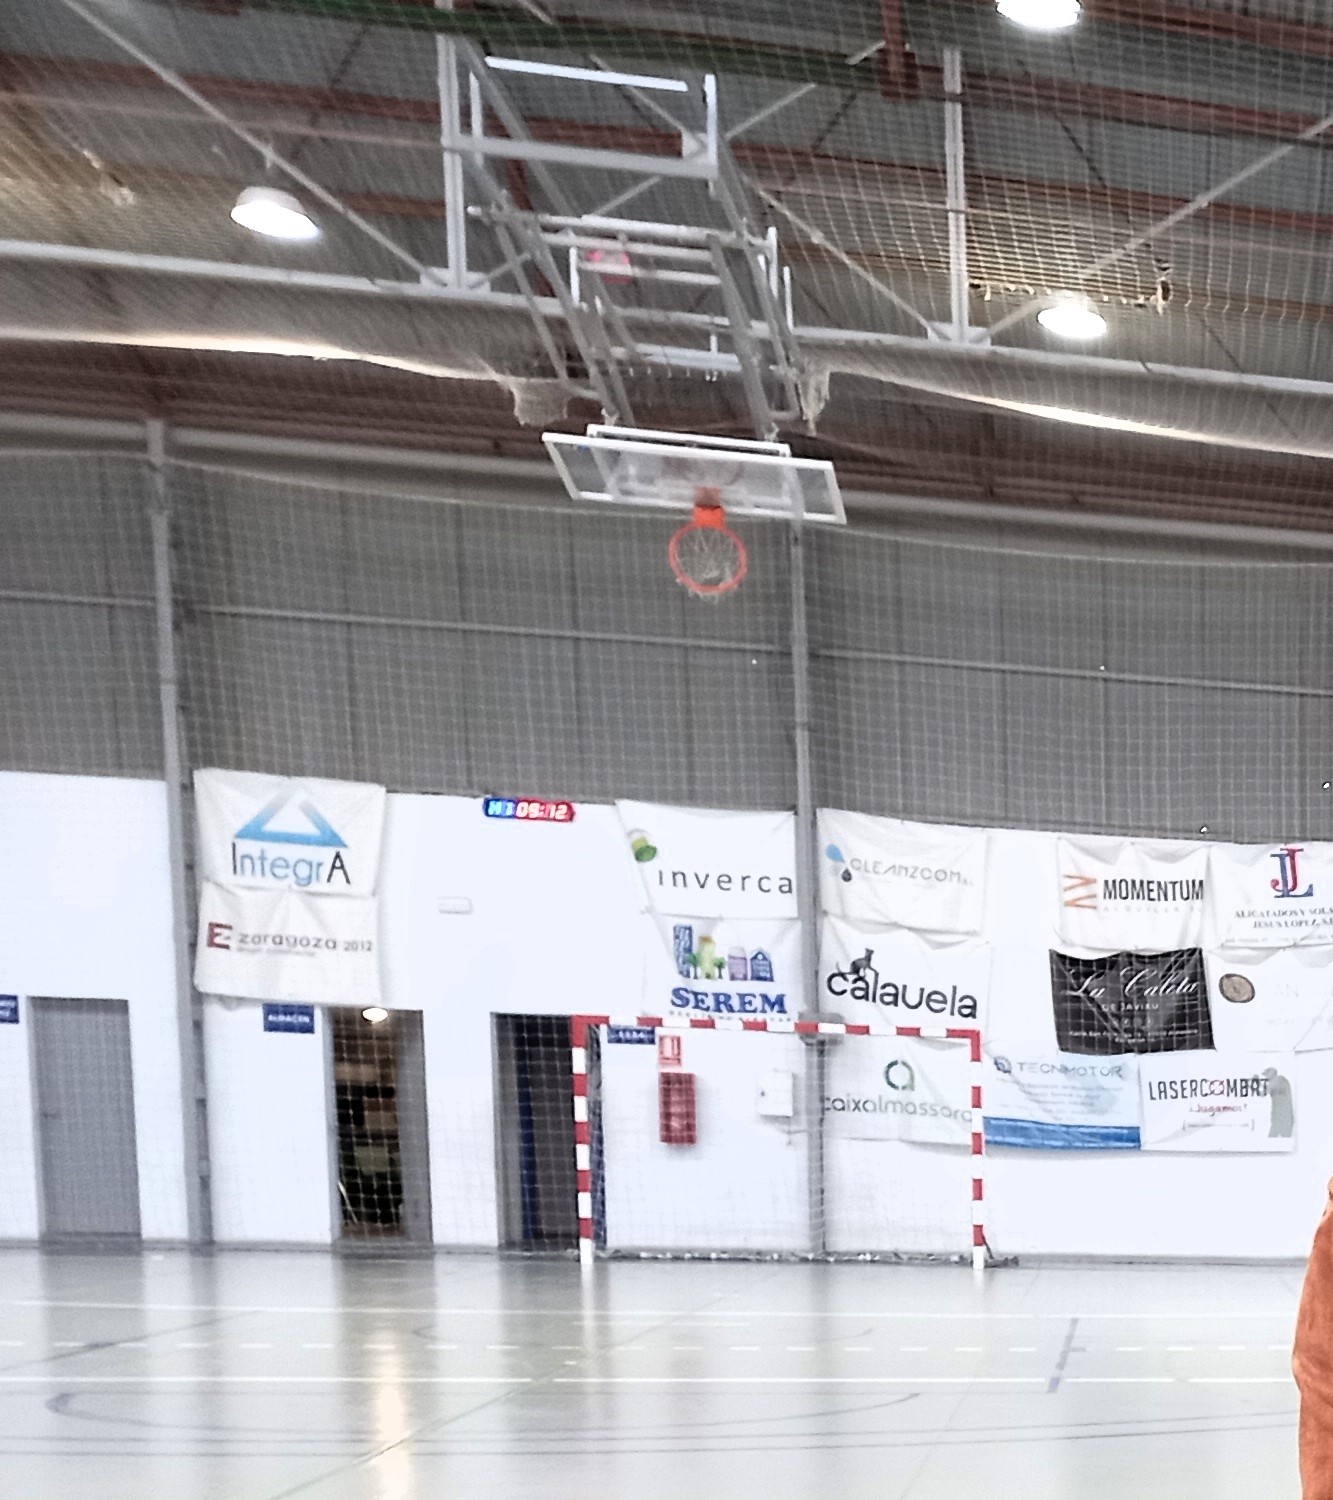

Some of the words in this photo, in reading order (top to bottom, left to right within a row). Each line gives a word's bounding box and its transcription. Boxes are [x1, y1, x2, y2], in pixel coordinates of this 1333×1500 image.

[231, 842, 351, 887] IntegrA
[658, 868, 793, 895] inverca
[1103, 878, 1204, 902] MOMENTUM
[670, 986, 788, 1014] SEREM
